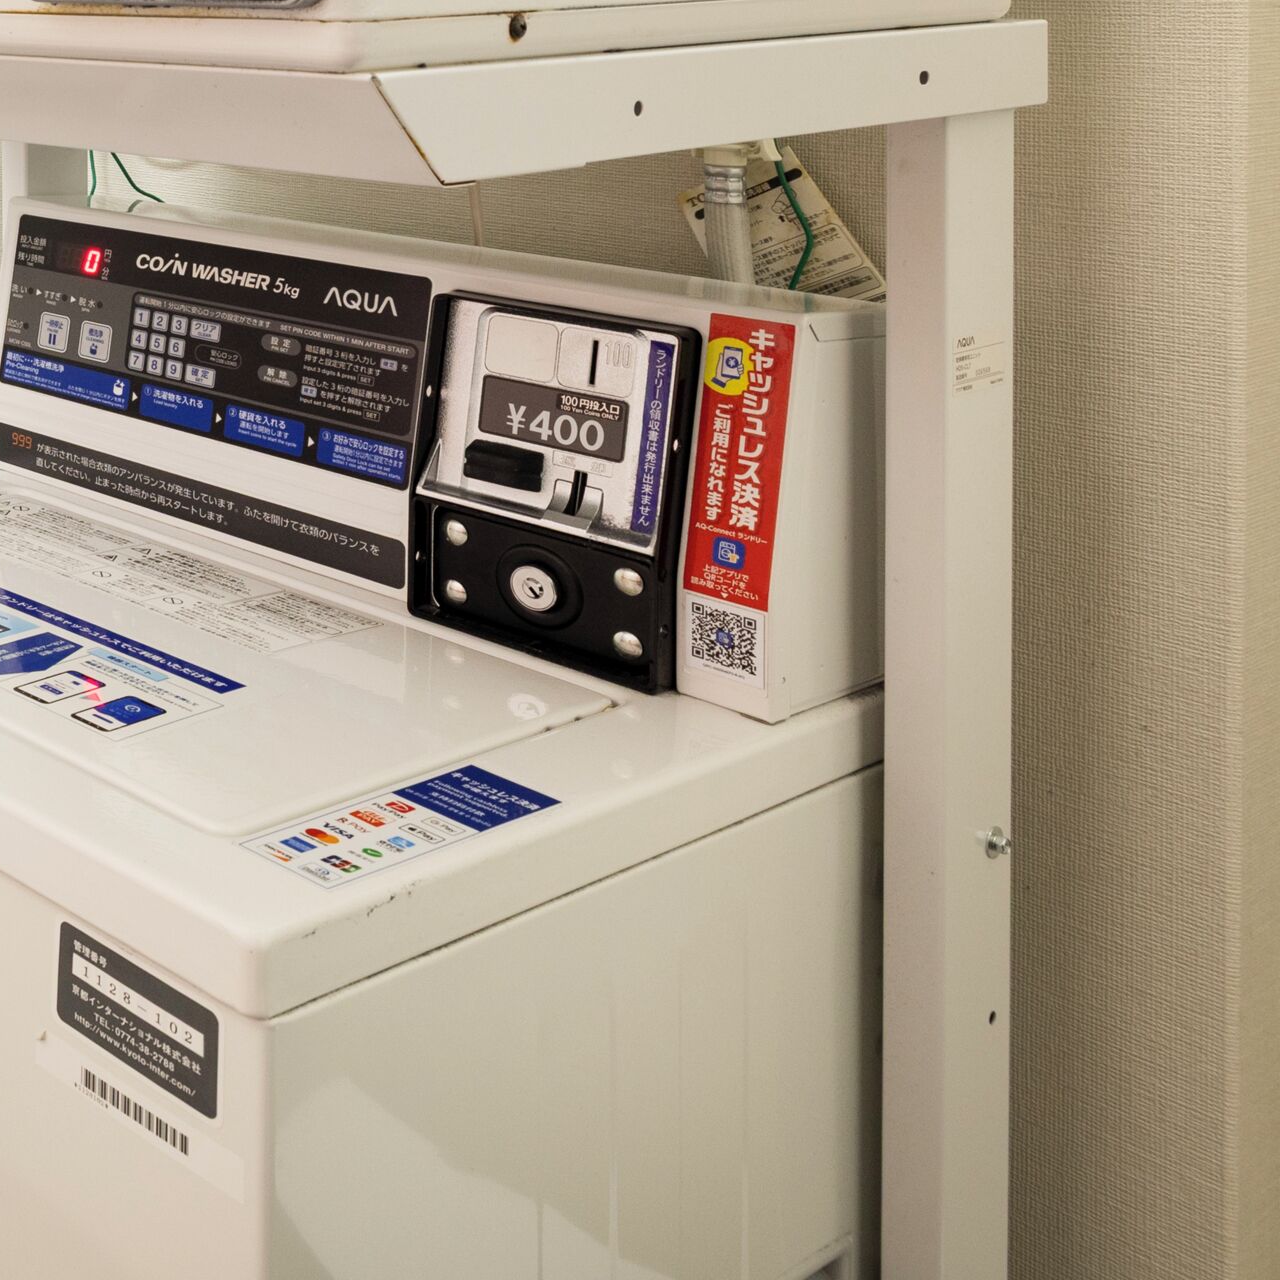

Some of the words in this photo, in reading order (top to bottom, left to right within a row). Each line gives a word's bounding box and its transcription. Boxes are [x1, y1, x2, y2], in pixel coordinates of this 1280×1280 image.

[20, 235, 47, 247] 投入金額
[18, 251, 45, 264] 残り時間
[84, 249, 101, 273] 0
[191, 262, 270, 291] WASHER
[272, 277, 300, 298] 5kg
[44, 291, 62, 301] すすぎ
[78, 297, 96, 308] 脱水
[323, 286, 398, 317] AQUA
[194, 322, 217, 333] クリア
[270, 336, 291, 348] 設定
[292, 325, 303, 335] PIN
[304, 328, 321, 338] CODE
[323, 332, 345, 342] WITHIN
[351, 337, 363, 346] MIN
[365, 340, 386, 350] AFTER
[387, 344, 409, 355] START
[210, 349, 239, 361] 安心ロック
[5, 361, 39, 375] Pre-Cleaning
[153, 388, 204, 408] 洗濯物を入れる
[238, 409, 286, 430] 硬貨を入れる
[601, 412, 619, 421] ONLY
[239, 420, 288, 439] 運転を開始します
[506, 403, 605, 451] ¥400
[729, 329, 775, 531] キャッシュレス決済
[12, 431, 32, 450] 999
[637, 349, 667, 527] ランドリーの領収書は発行出来ません
[705, 403, 733, 521] ご利用になれます
[695, 522, 736, 538] AQ-Connect
[737, 532, 768, 544] ランドリー
[703, 563, 749, 583] 上記アプリで
[703, 573, 746, 590] QRコードを
[690, 576, 759, 601] 読み取ってください
[323, 822, 355, 839] VISA
[73, 939, 108, 969] 管理番号
[72, 984, 202, 1076] 京都インターナショナル株式会社
[74, 1011, 197, 1097] http://www.kyoto-inter.com/
